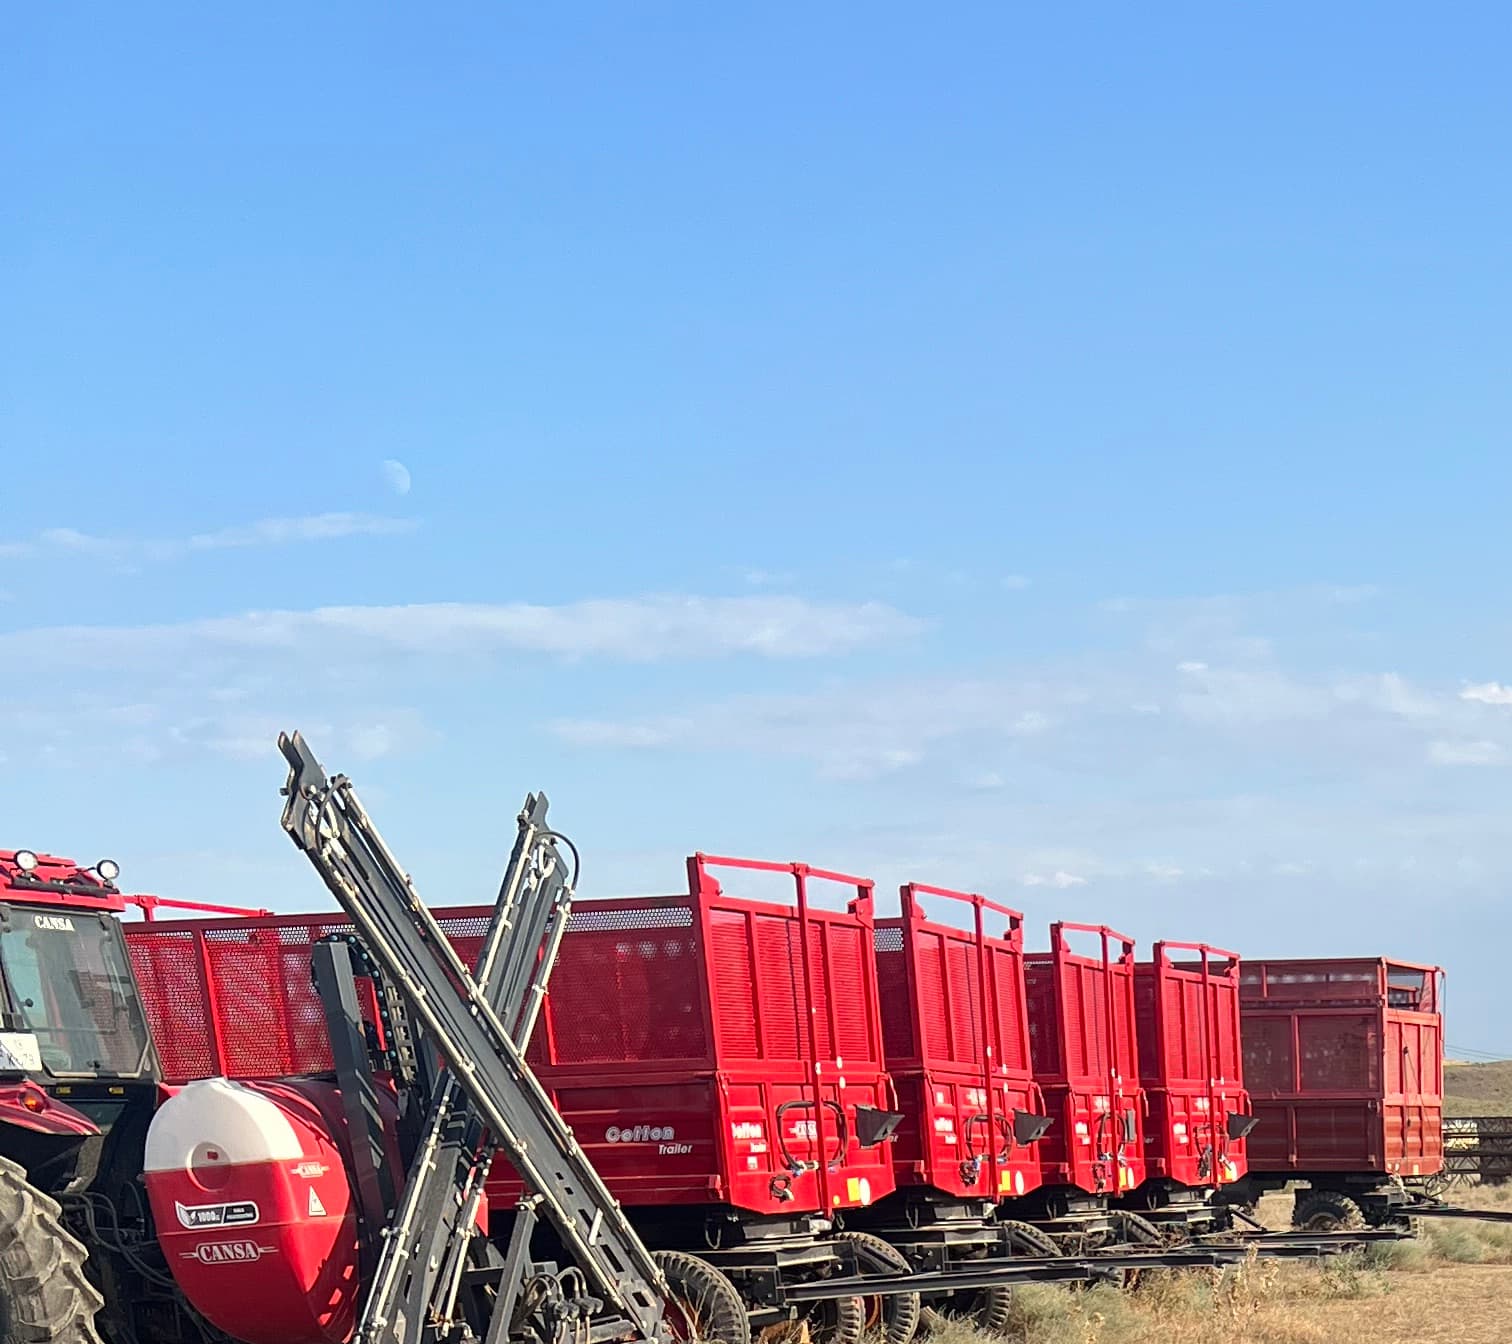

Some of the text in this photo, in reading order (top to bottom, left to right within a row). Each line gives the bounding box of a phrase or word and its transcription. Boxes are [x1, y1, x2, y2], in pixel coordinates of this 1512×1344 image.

[34, 915, 75, 932] CANSA
[658, 1143, 693, 1155] Trailer
[200, 1242, 259, 1262] CANSA
